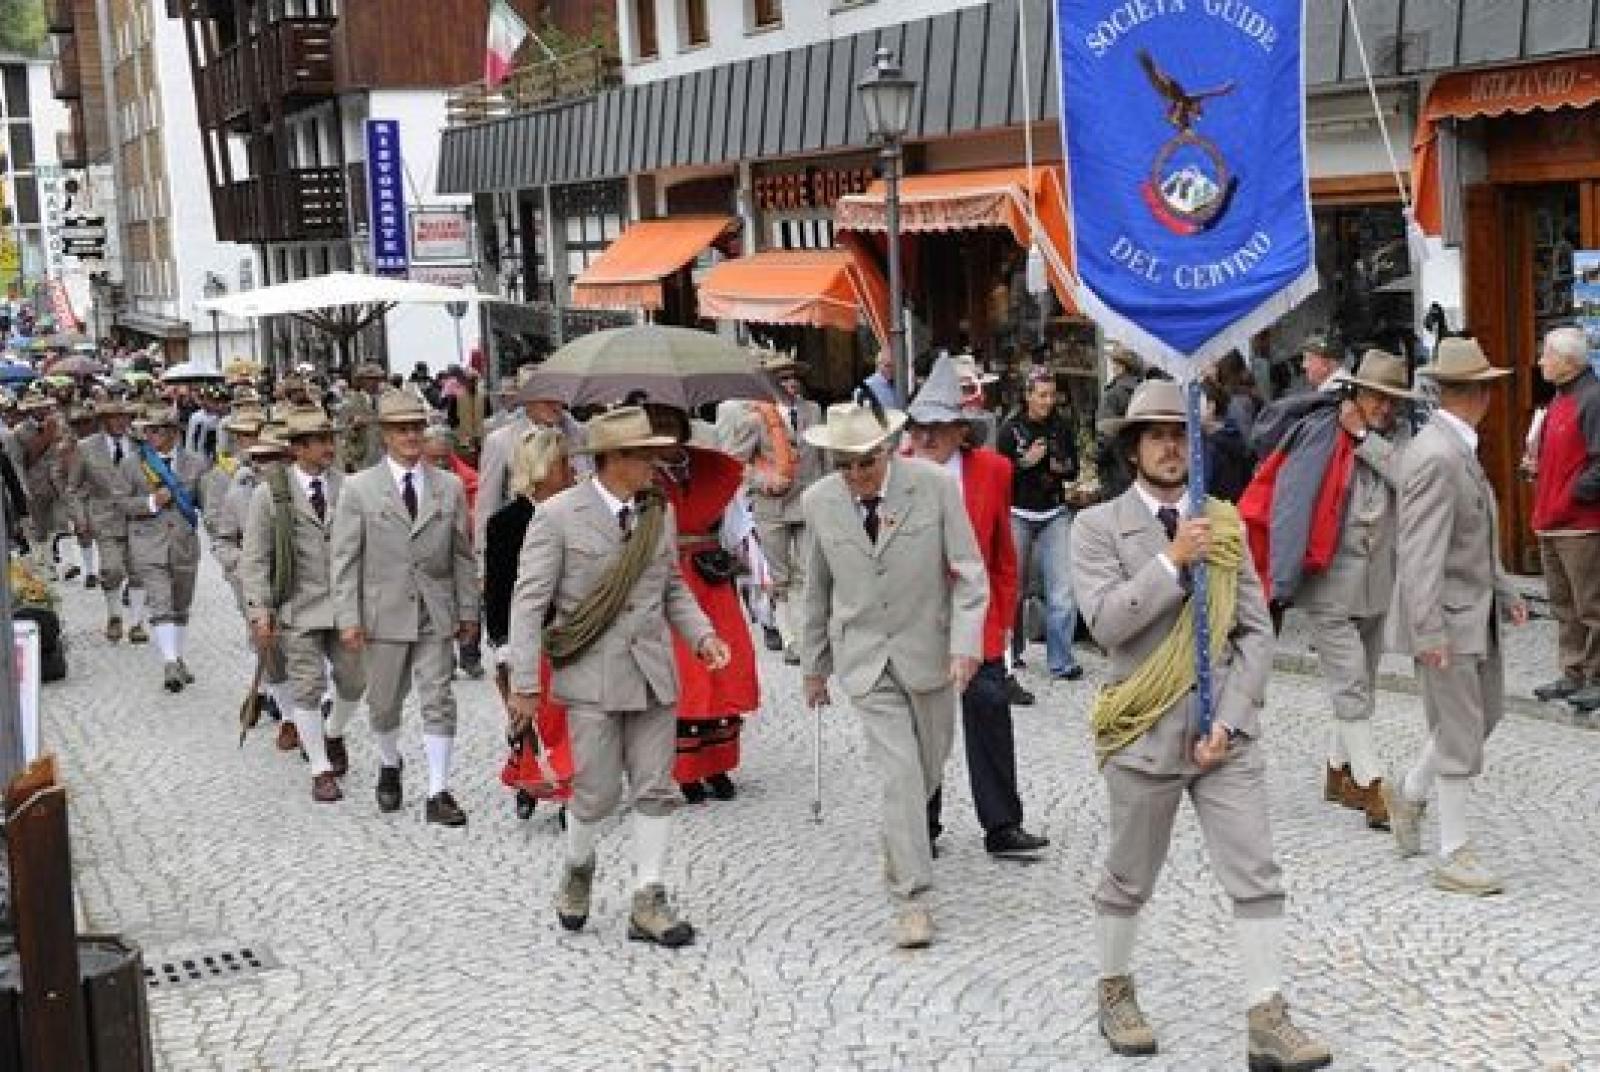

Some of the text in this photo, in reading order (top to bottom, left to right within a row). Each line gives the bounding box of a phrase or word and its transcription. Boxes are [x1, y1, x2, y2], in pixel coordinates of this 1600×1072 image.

[375, 123, 397, 251] RISTORANTE
[1110, 231, 1271, 290] DEL CERVINO
